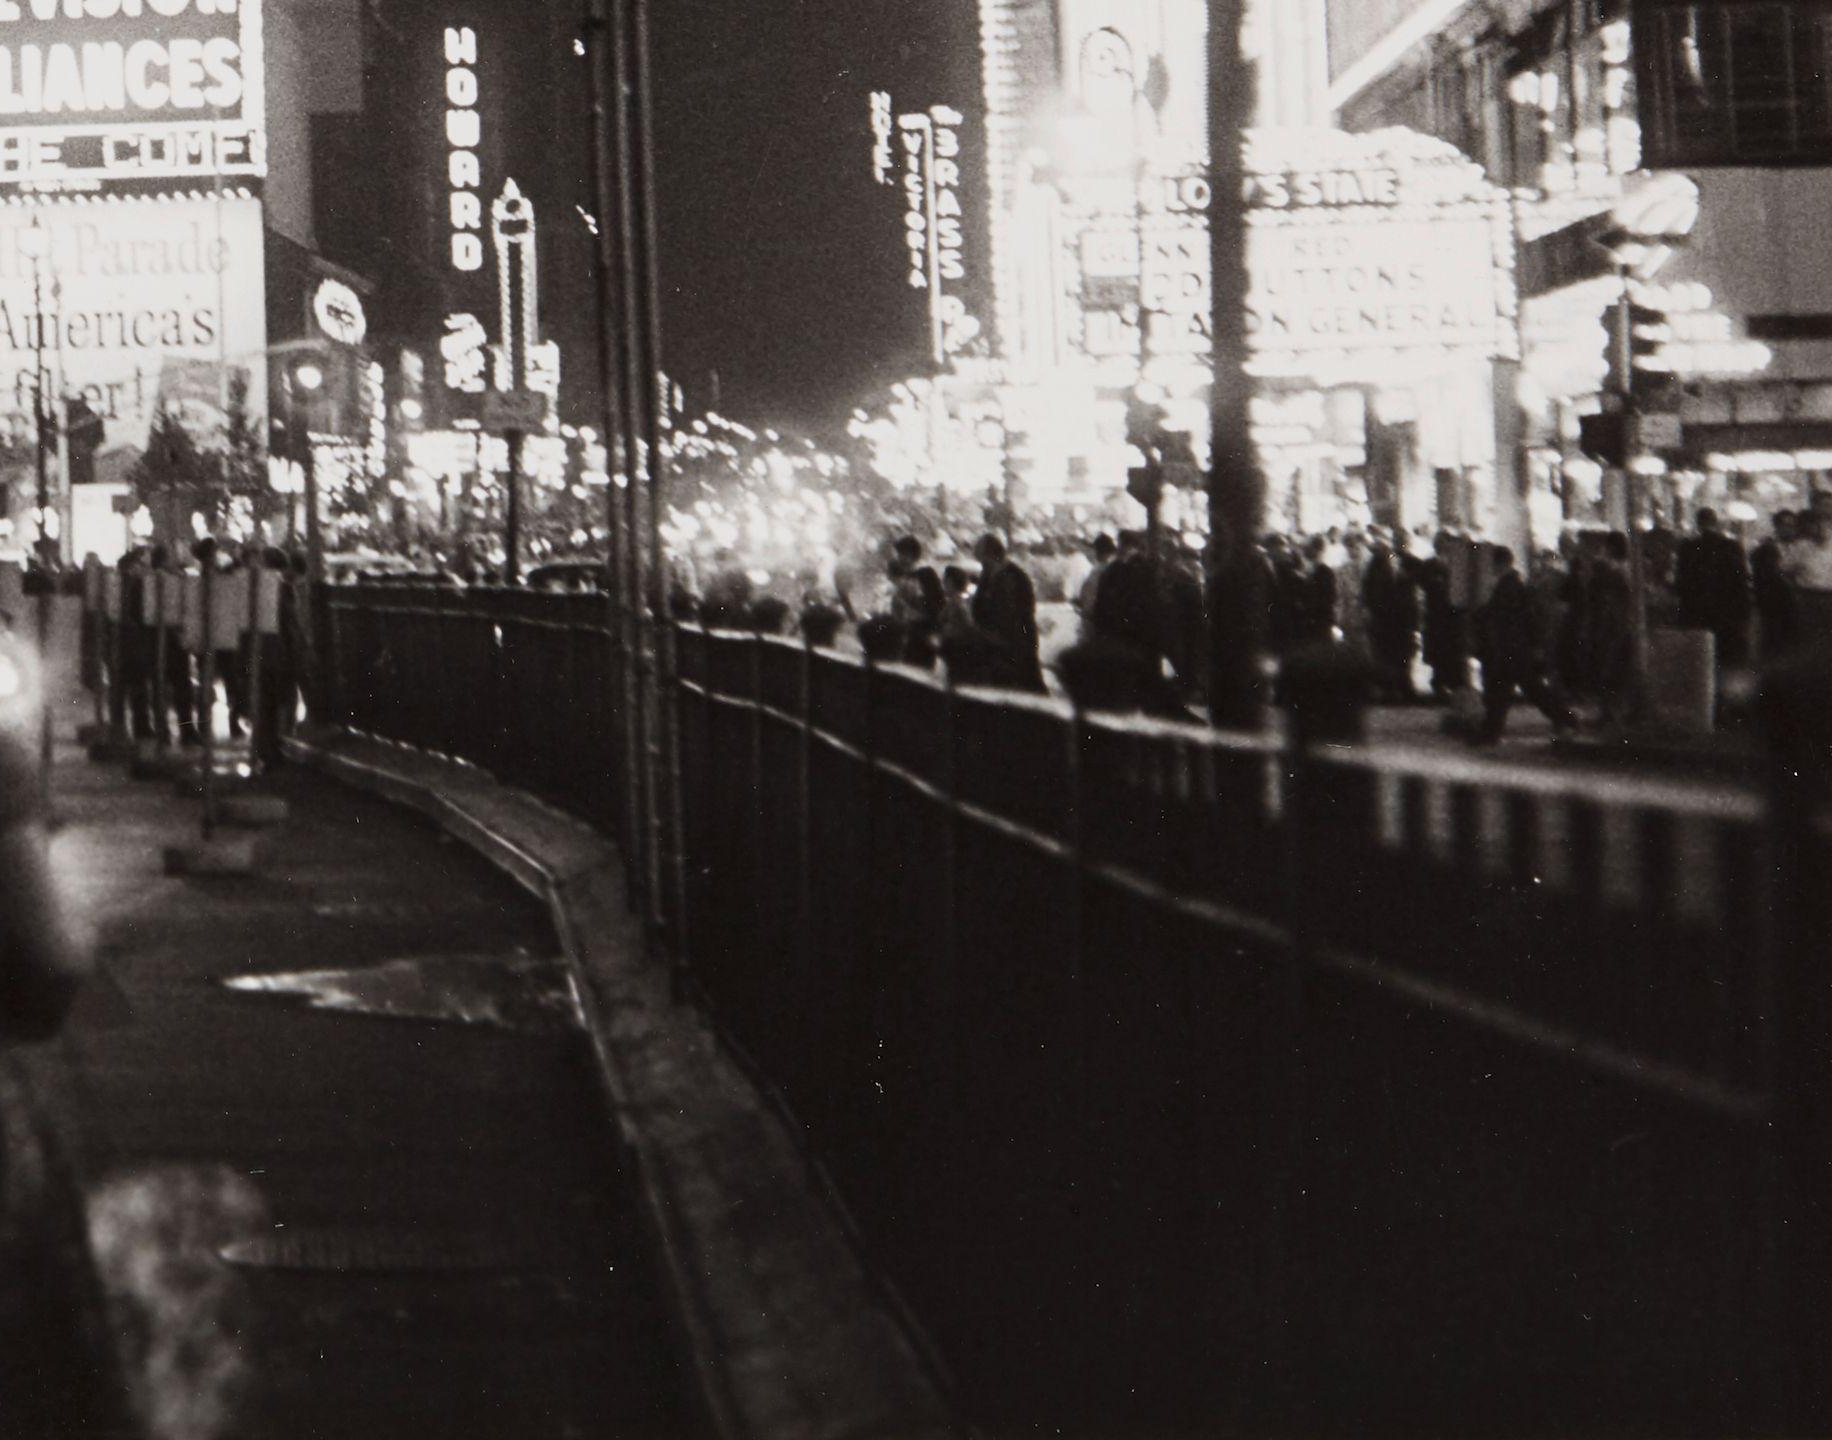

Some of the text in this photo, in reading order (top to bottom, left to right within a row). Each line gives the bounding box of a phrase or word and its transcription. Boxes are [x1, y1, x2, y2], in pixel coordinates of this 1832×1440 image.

[444, 27, 483, 272] HOWARD
[1293, 167, 1400, 208] STATE
[72, 220, 232, 278] Parade
[901, 131, 928, 288] VICTORIA
[934, 127, 965, 280] BRASS
[1262, 264, 1426, 295] UTTONS
